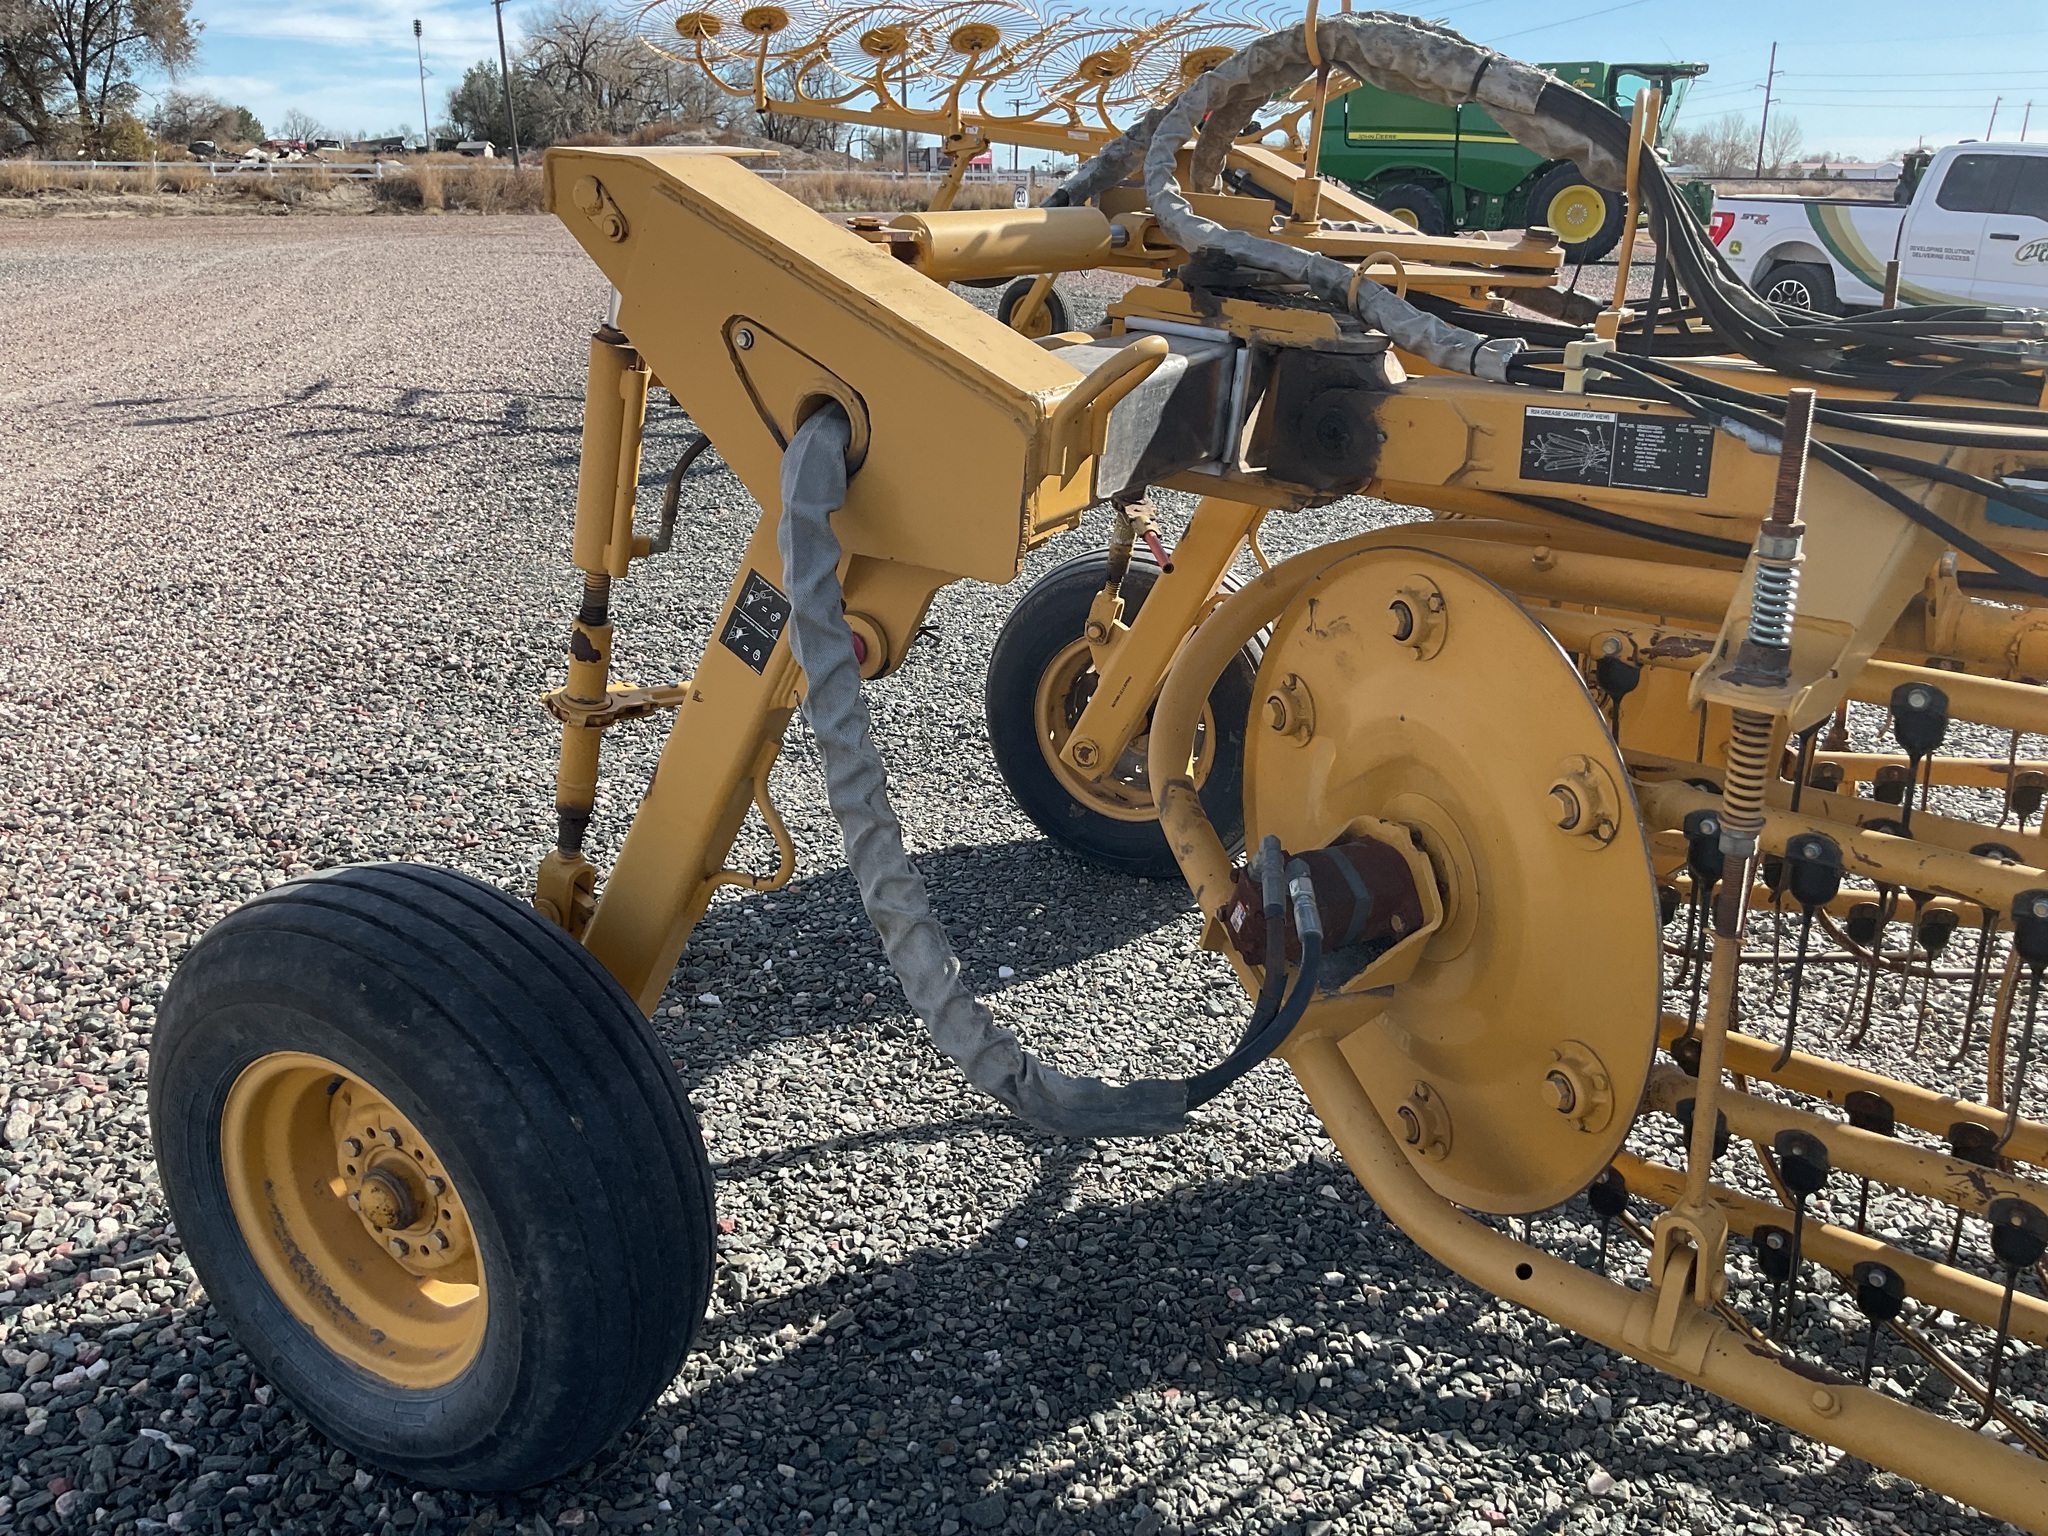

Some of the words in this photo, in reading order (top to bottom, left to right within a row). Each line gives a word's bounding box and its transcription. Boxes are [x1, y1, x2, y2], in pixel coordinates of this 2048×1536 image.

[1016, 190, 1026, 203] 20
[1909, 245, 1943, 253] DEVELOPING
[1911, 251, 1944, 260] DELIVERING
[1540, 409, 1562, 417] GREASE
[1562, 410, 1581, 418] CHART
